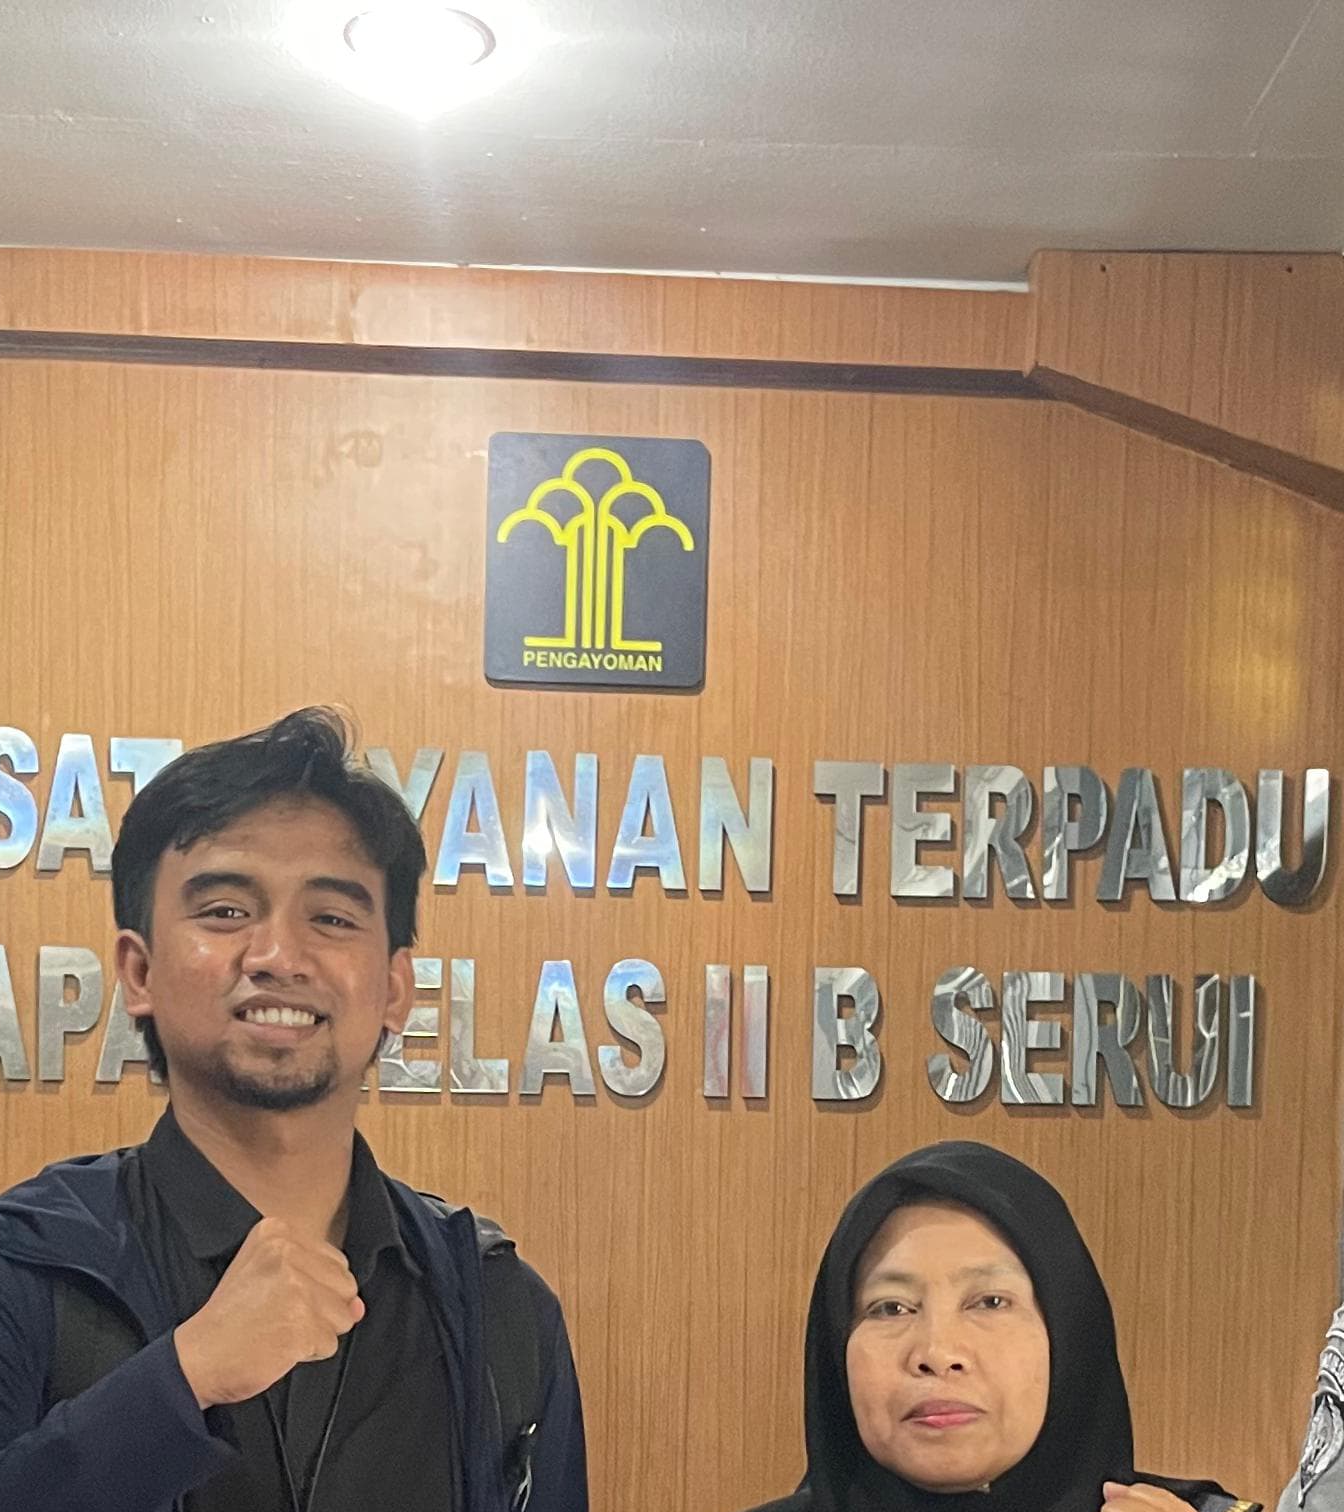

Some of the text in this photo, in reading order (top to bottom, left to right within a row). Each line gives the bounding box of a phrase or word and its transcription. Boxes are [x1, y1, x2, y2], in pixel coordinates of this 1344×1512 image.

[522, 650, 663, 672] PENGAYOMAN
[364, 746, 774, 893] YANAN
[813, 760, 1331, 905] TERPADU
[360, 957, 667, 1097] ELAS
[703, 964, 768, 1098] II
[810, 966, 882, 1100] B
[926, 965, 1256, 1108] SERUI
